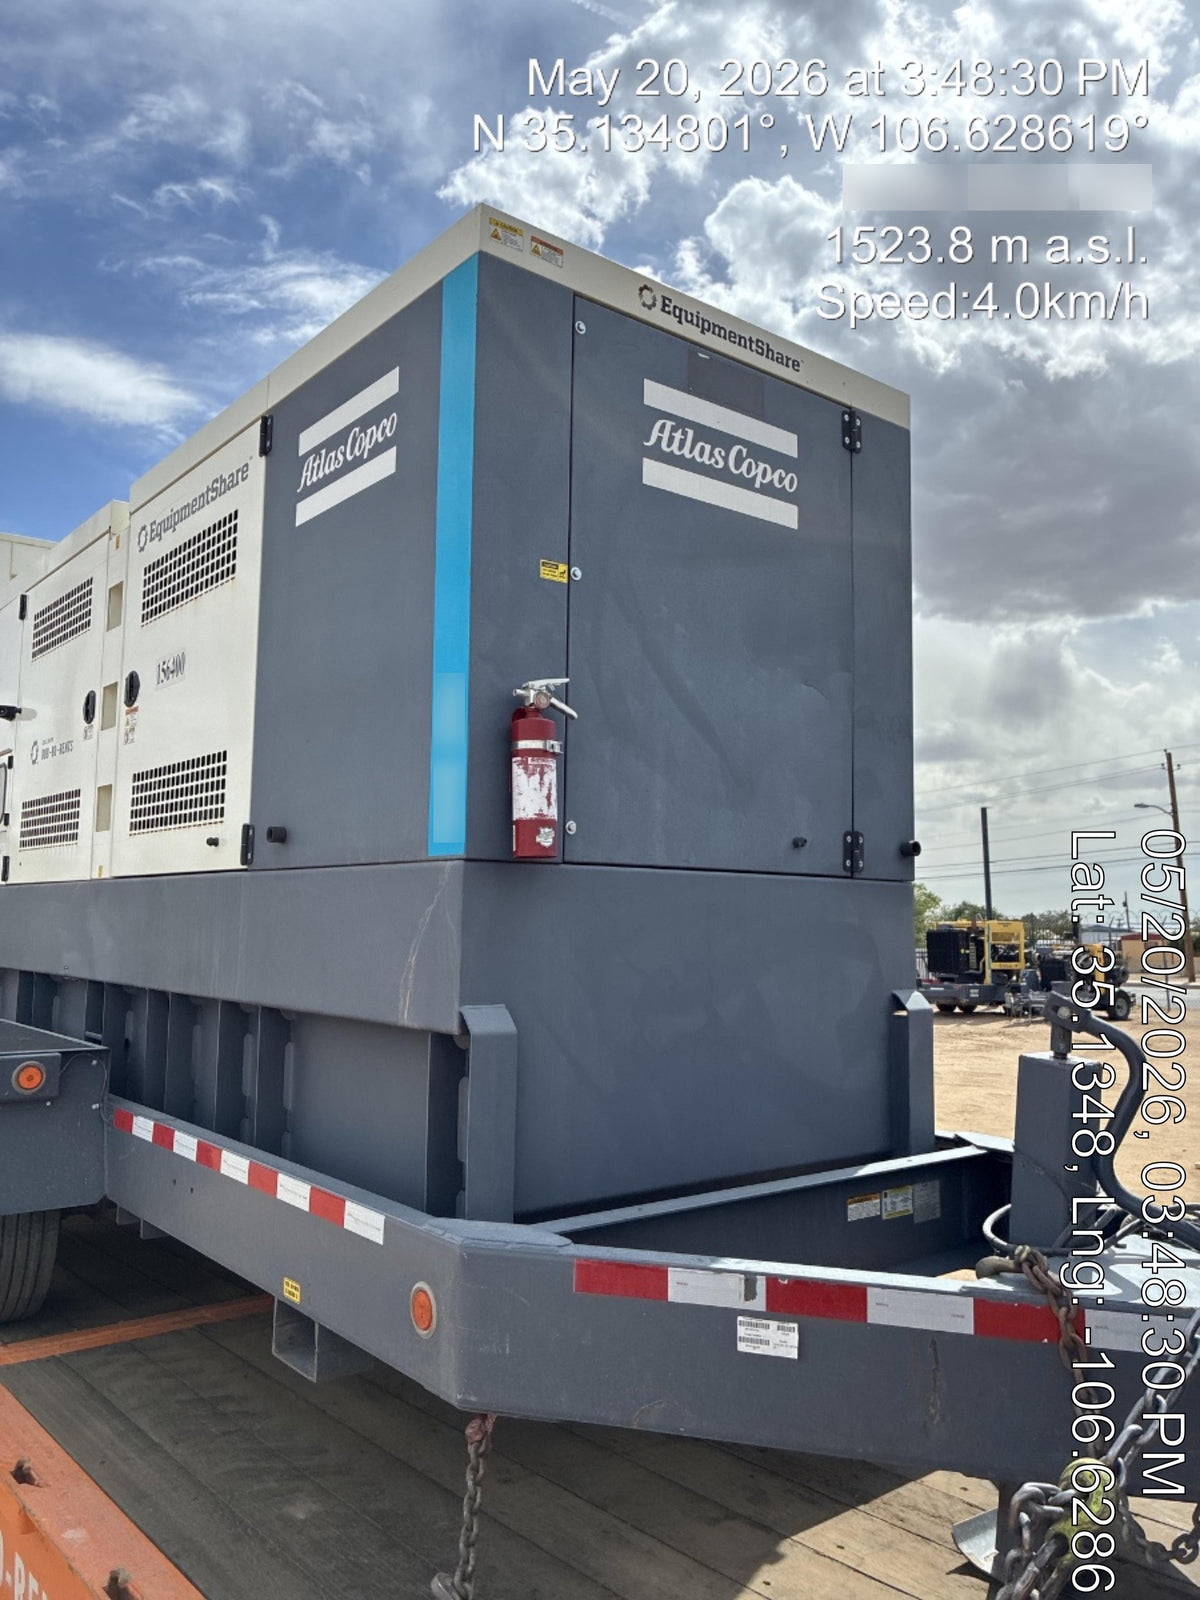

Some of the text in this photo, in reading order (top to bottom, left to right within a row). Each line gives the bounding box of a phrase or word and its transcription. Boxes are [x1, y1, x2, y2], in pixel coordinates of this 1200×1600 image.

[660, 295, 801, 373] EquipmentShare
[297, 412, 398, 493] Atlas Copco
[643, 419, 798, 493] Atlas Copco
[149, 462, 249, 542] EquipmentShare
